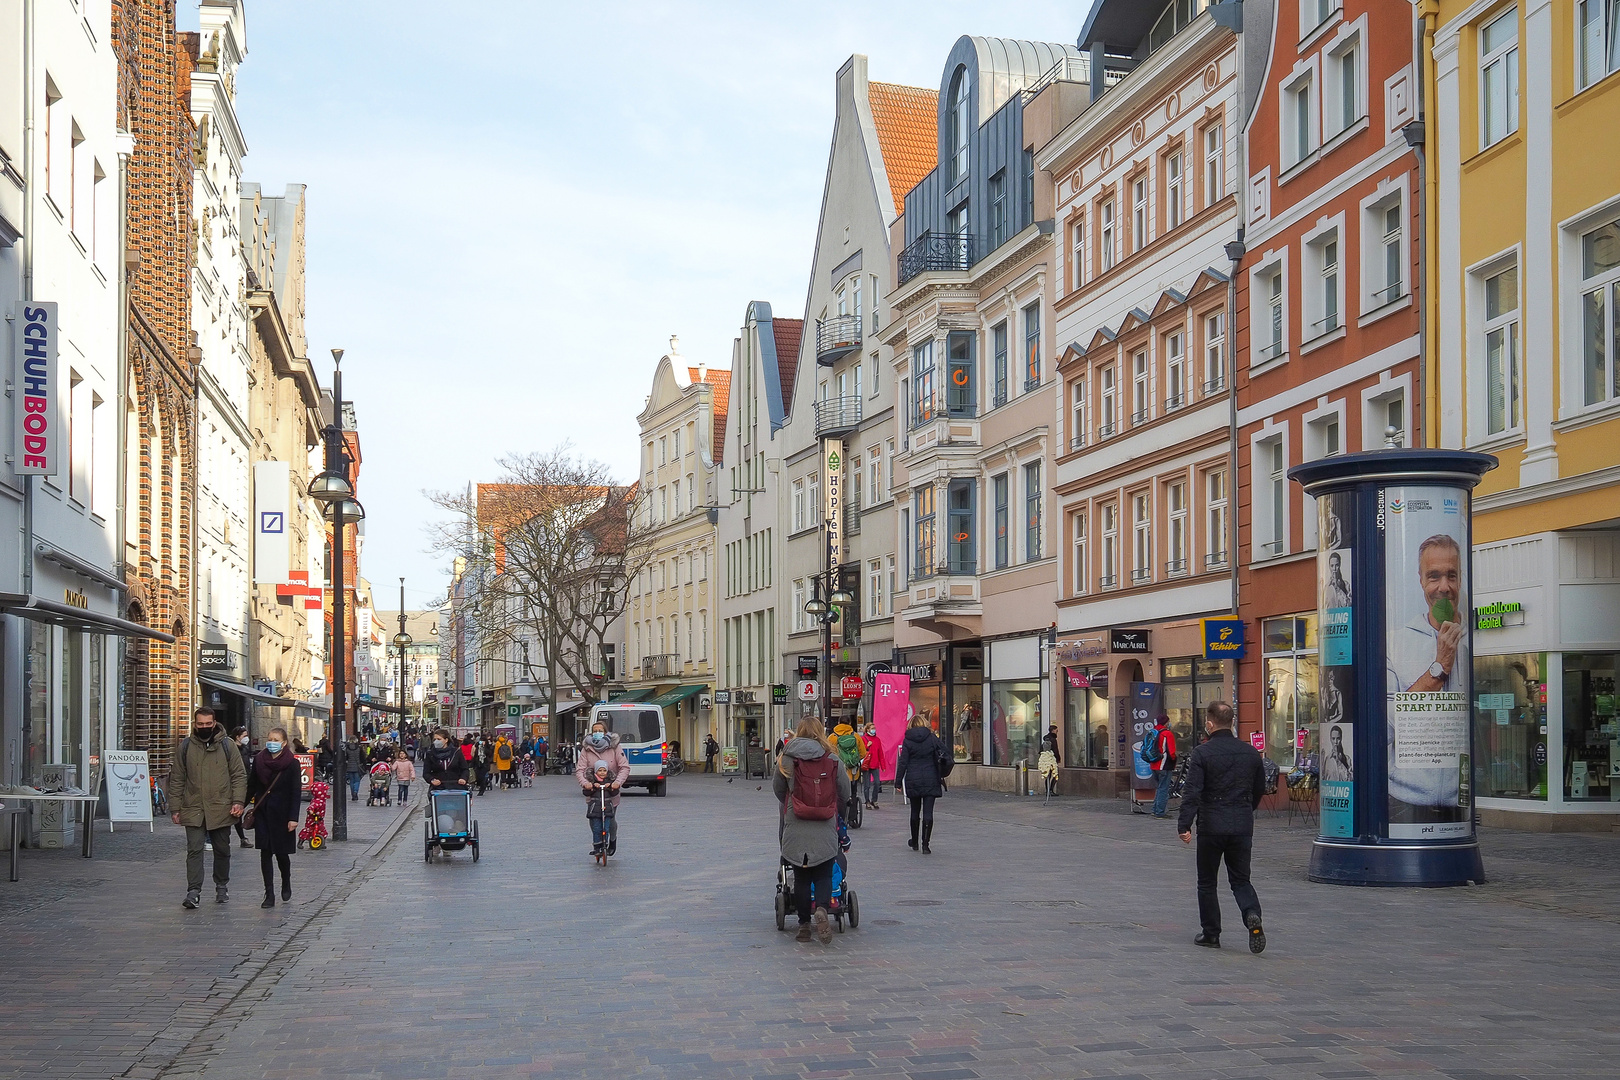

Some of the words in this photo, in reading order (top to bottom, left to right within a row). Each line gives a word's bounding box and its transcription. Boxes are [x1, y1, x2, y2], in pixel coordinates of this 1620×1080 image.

[1376, 490, 1384, 530] JCDecaux
[1478, 602, 1520, 616] mobilcom
[1478, 616, 1502, 629] debitel
[1210, 642, 1242, 650] Tchibo
[1396, 693, 1426, 701] STOP
[1132, 708, 1148, 719] to
